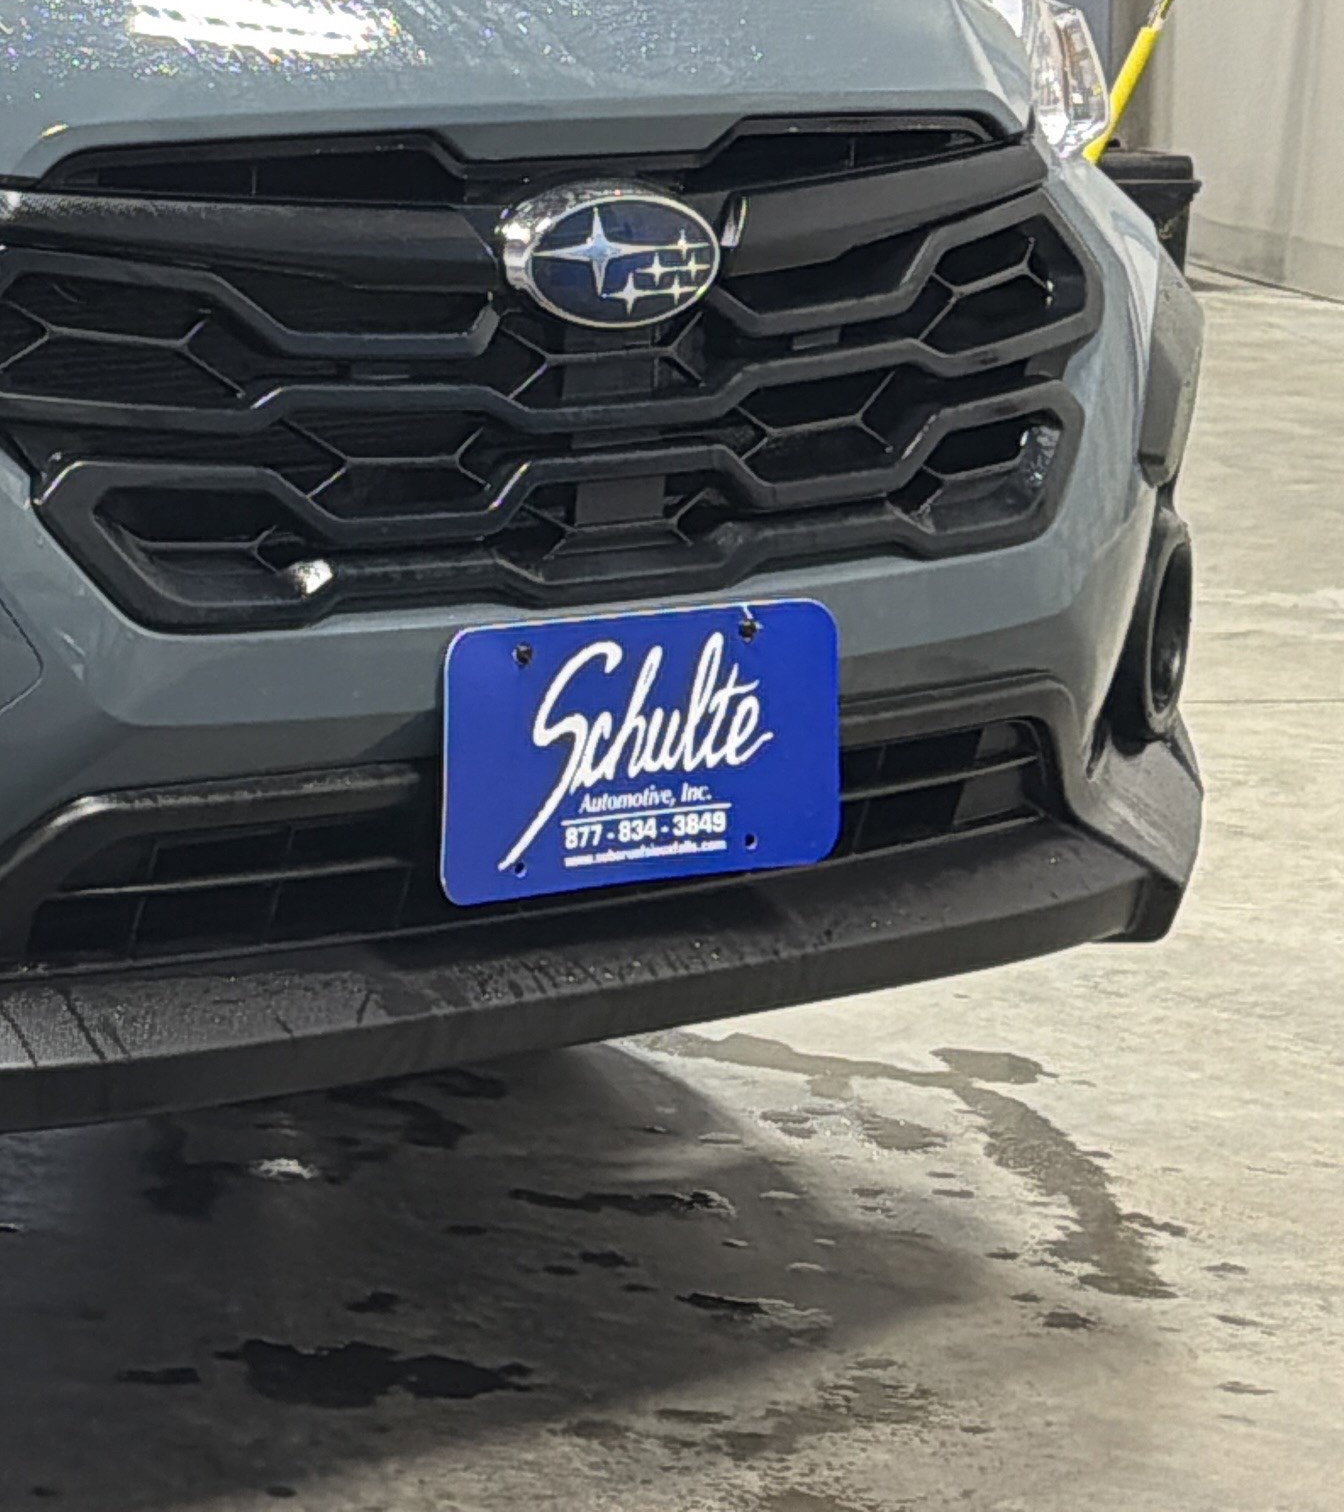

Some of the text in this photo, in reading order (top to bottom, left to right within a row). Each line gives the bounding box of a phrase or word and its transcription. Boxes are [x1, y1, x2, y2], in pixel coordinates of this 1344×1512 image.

[497, 630, 774, 872] Schulte
[680, 782, 713, 804] Inc.
[564, 823, 603, 850] 877
[617, 816, 658, 843] 834
[671, 810, 727, 837] 3849
